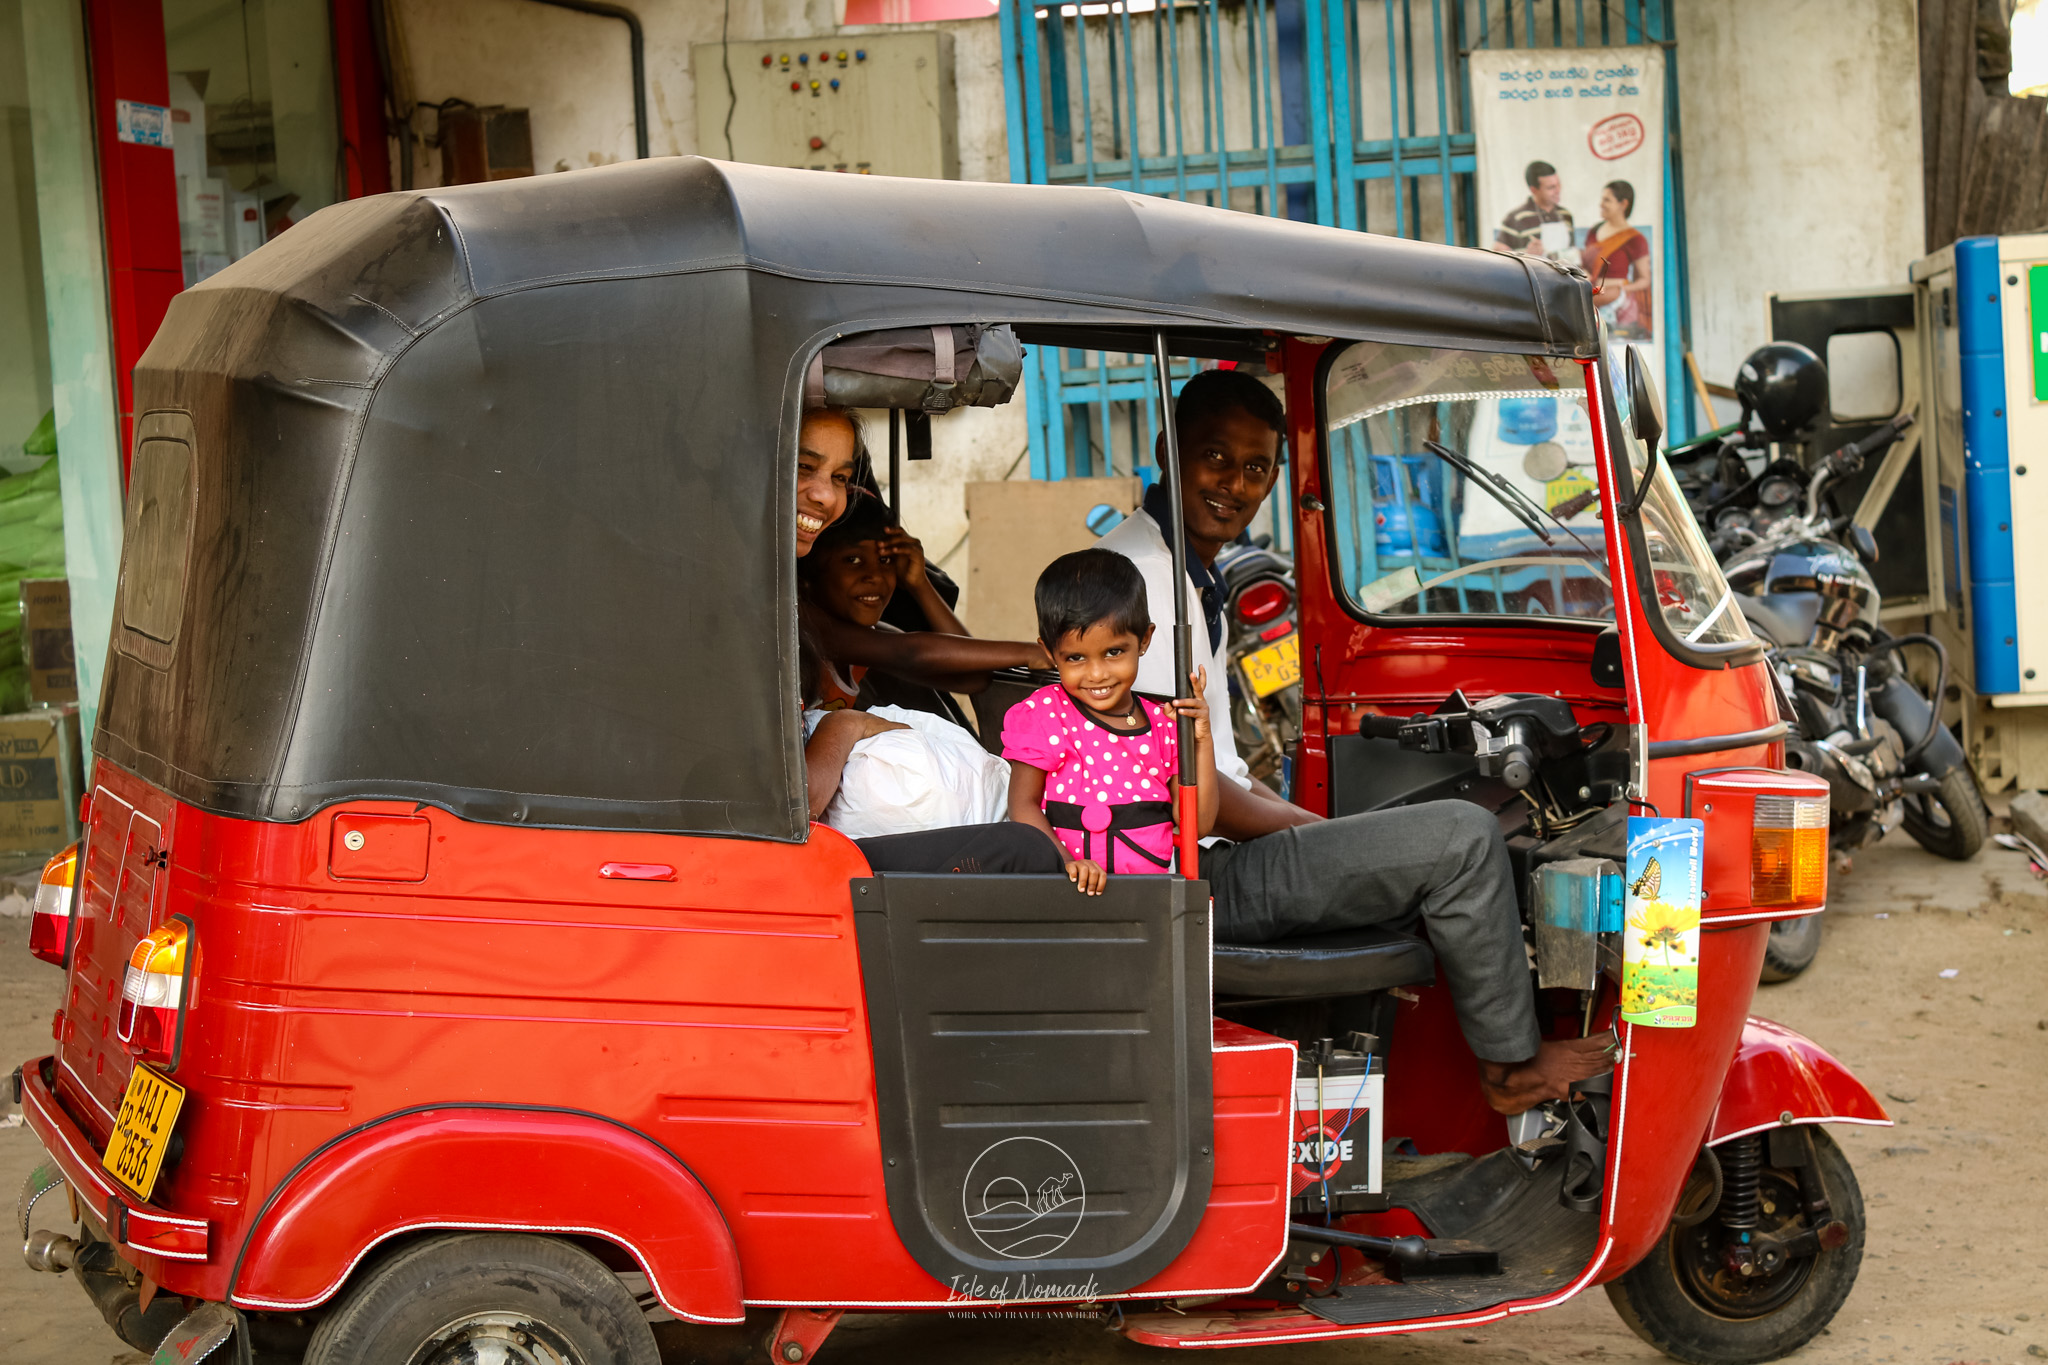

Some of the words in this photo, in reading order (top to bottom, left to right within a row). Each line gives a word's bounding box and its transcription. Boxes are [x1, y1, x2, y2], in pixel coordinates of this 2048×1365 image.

[1253, 664, 1273, 679] CP
[117, 1101, 134, 1134] CP
[117, 1129, 153, 1187] 8536
